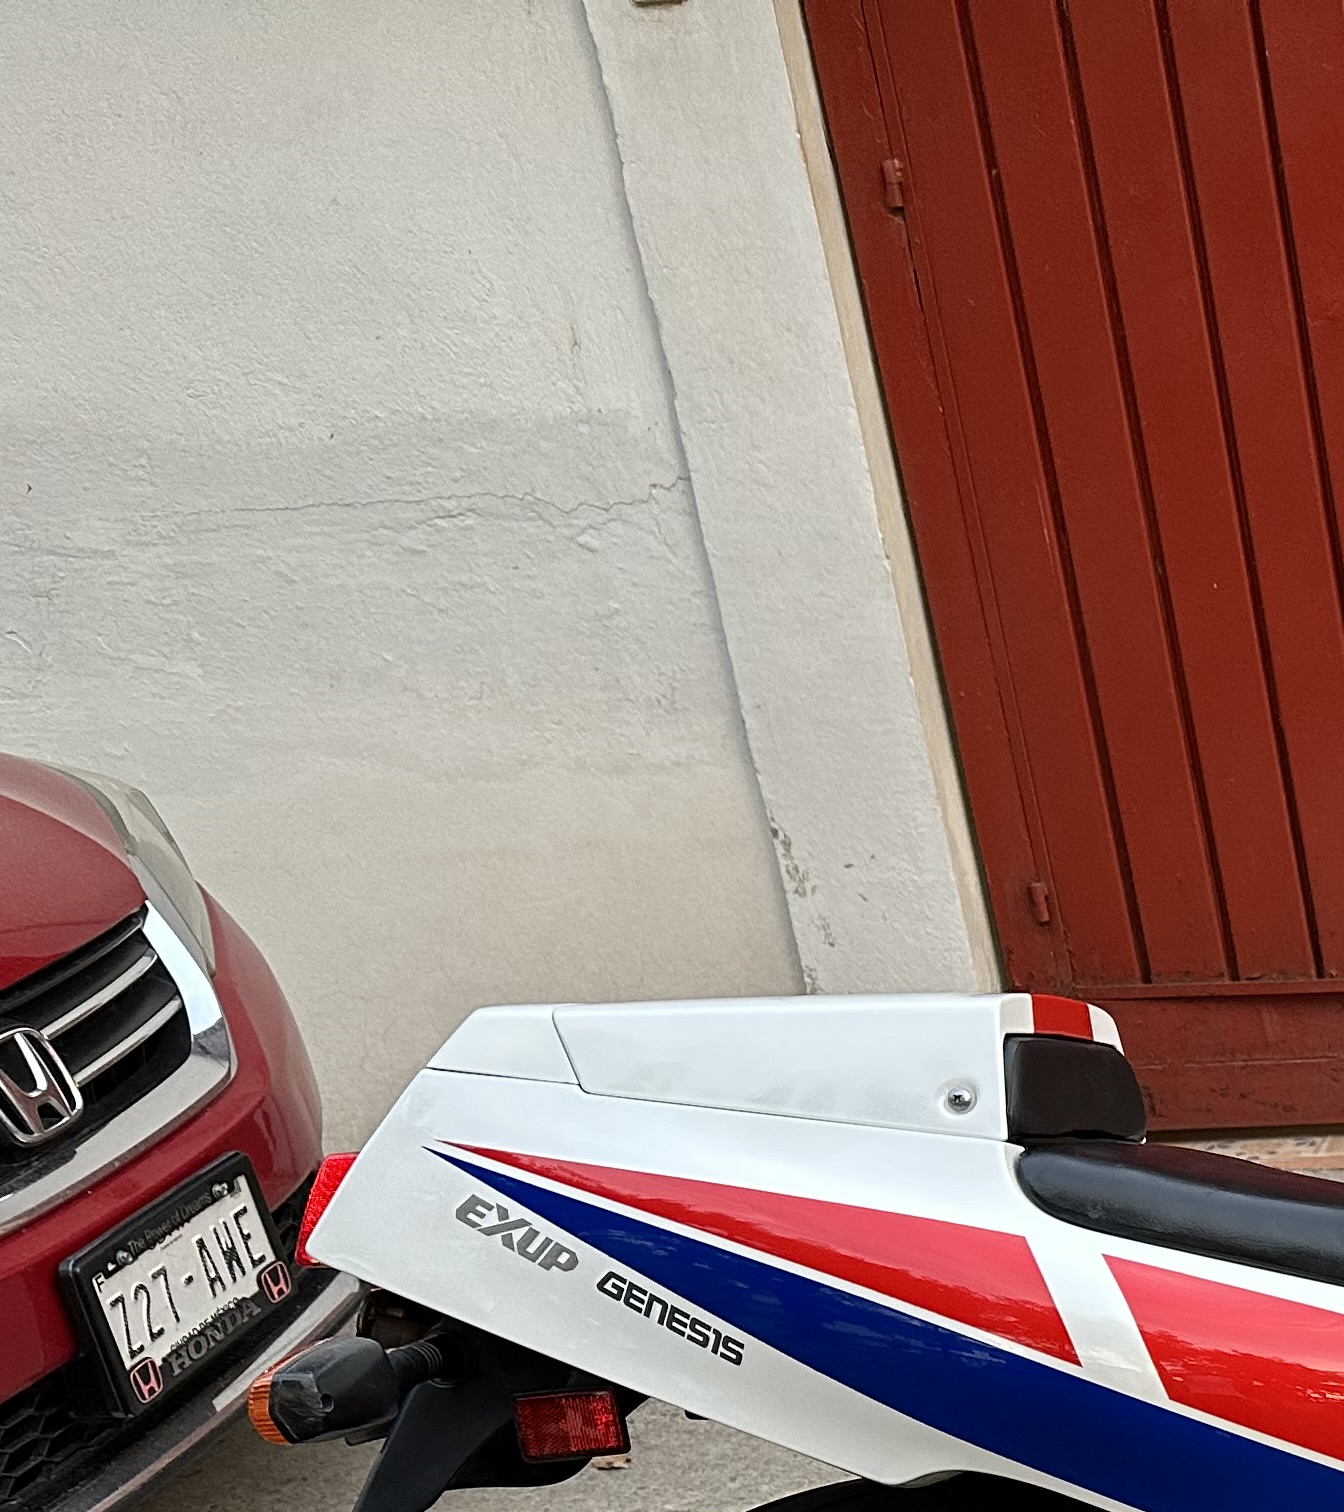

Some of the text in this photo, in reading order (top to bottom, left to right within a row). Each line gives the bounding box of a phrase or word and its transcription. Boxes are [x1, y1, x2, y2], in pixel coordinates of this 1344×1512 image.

[108, 1204, 267, 1361] Z27-AWE
[167, 1299, 262, 1377] HONDA
[454, 1192, 746, 1367] EXUP GENESIS
